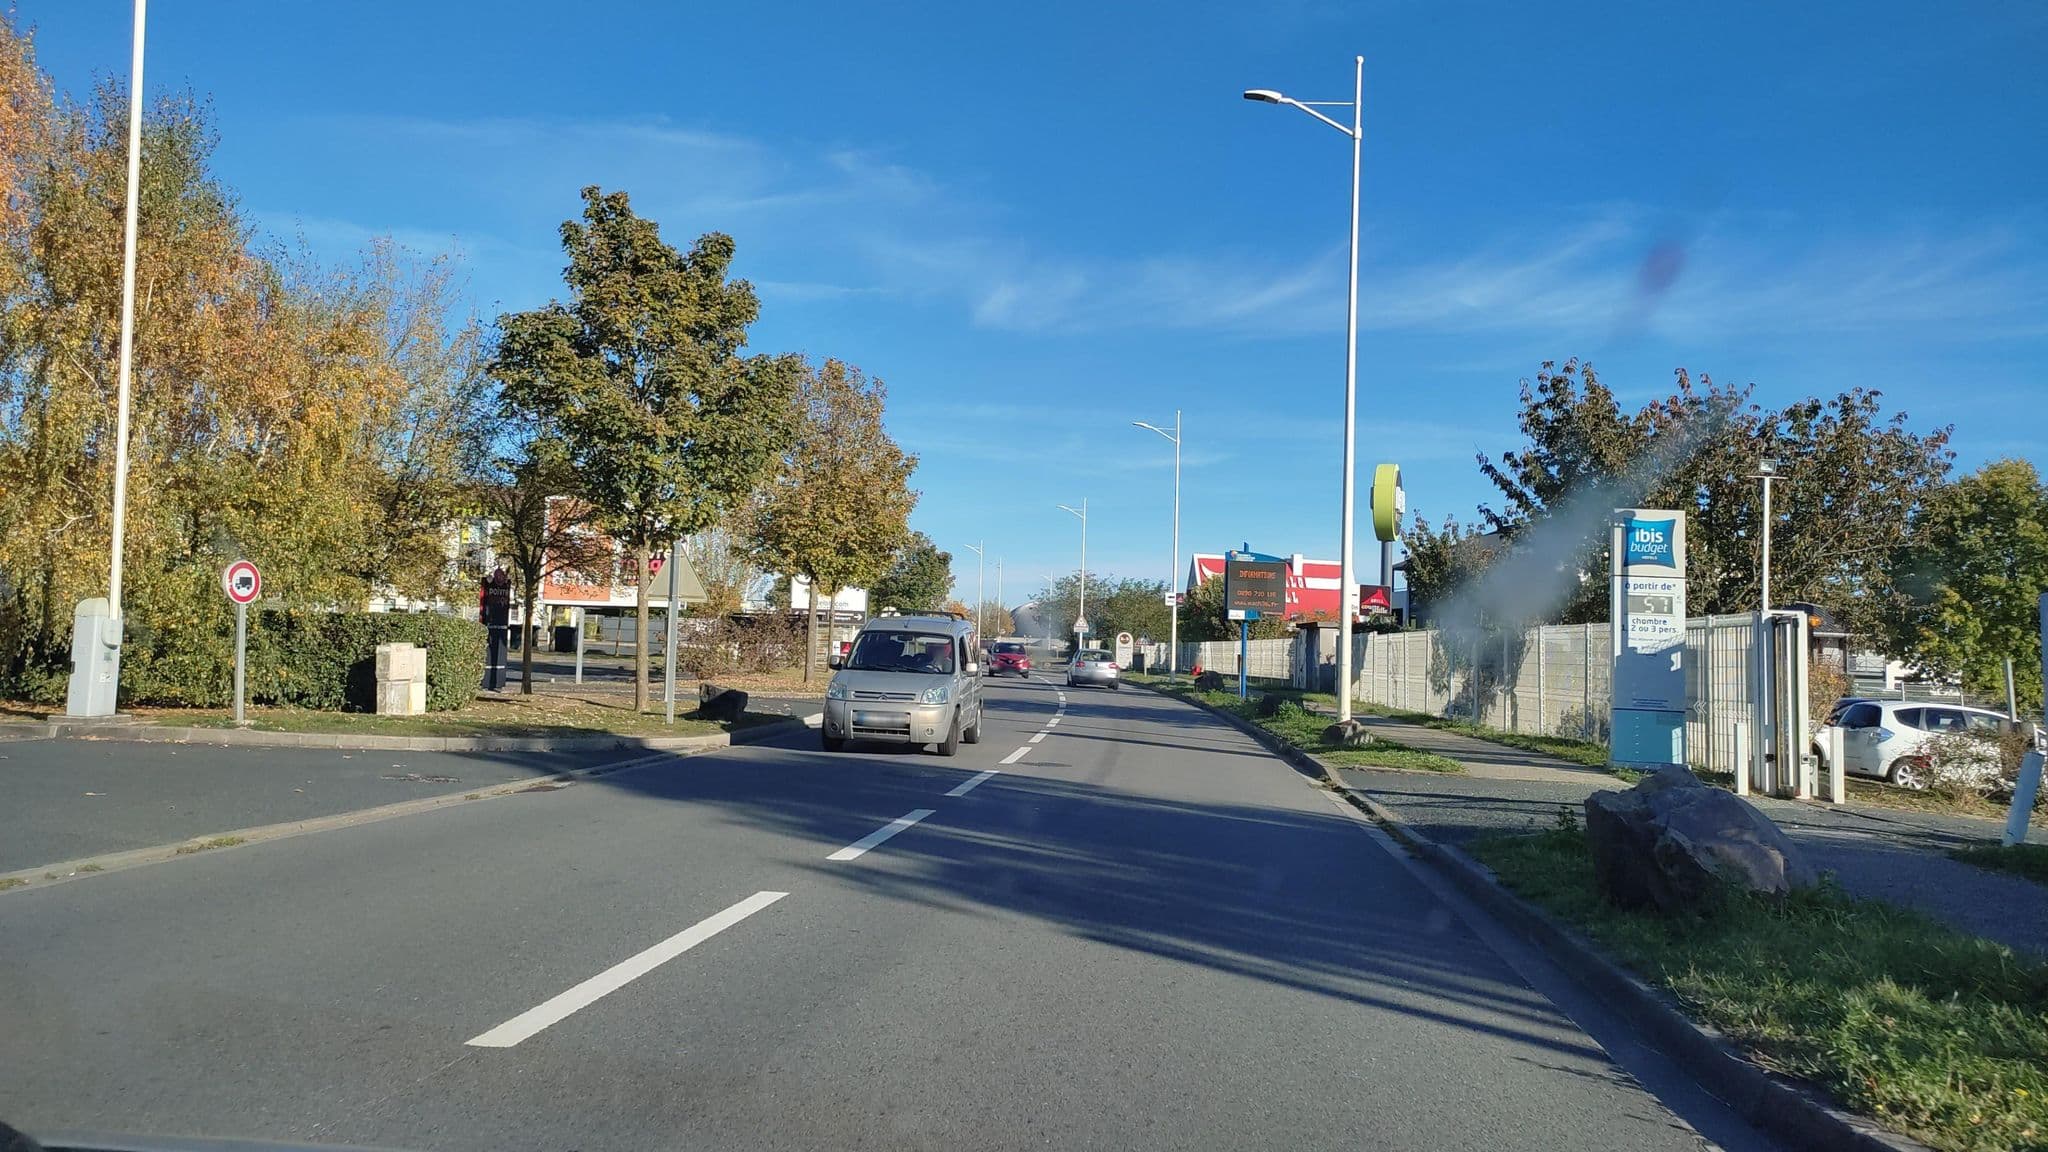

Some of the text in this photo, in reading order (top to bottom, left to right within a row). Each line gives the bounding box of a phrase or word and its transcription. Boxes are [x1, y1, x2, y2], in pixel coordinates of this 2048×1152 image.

[1635, 528, 1664, 543] ibis
[1630, 542, 1669, 555] budget
[1633, 582, 1658, 590] partir
[1631, 617, 1668, 625] chambre
[1631, 624, 1637, 632] 2
[1651, 625, 1657, 633] 3
